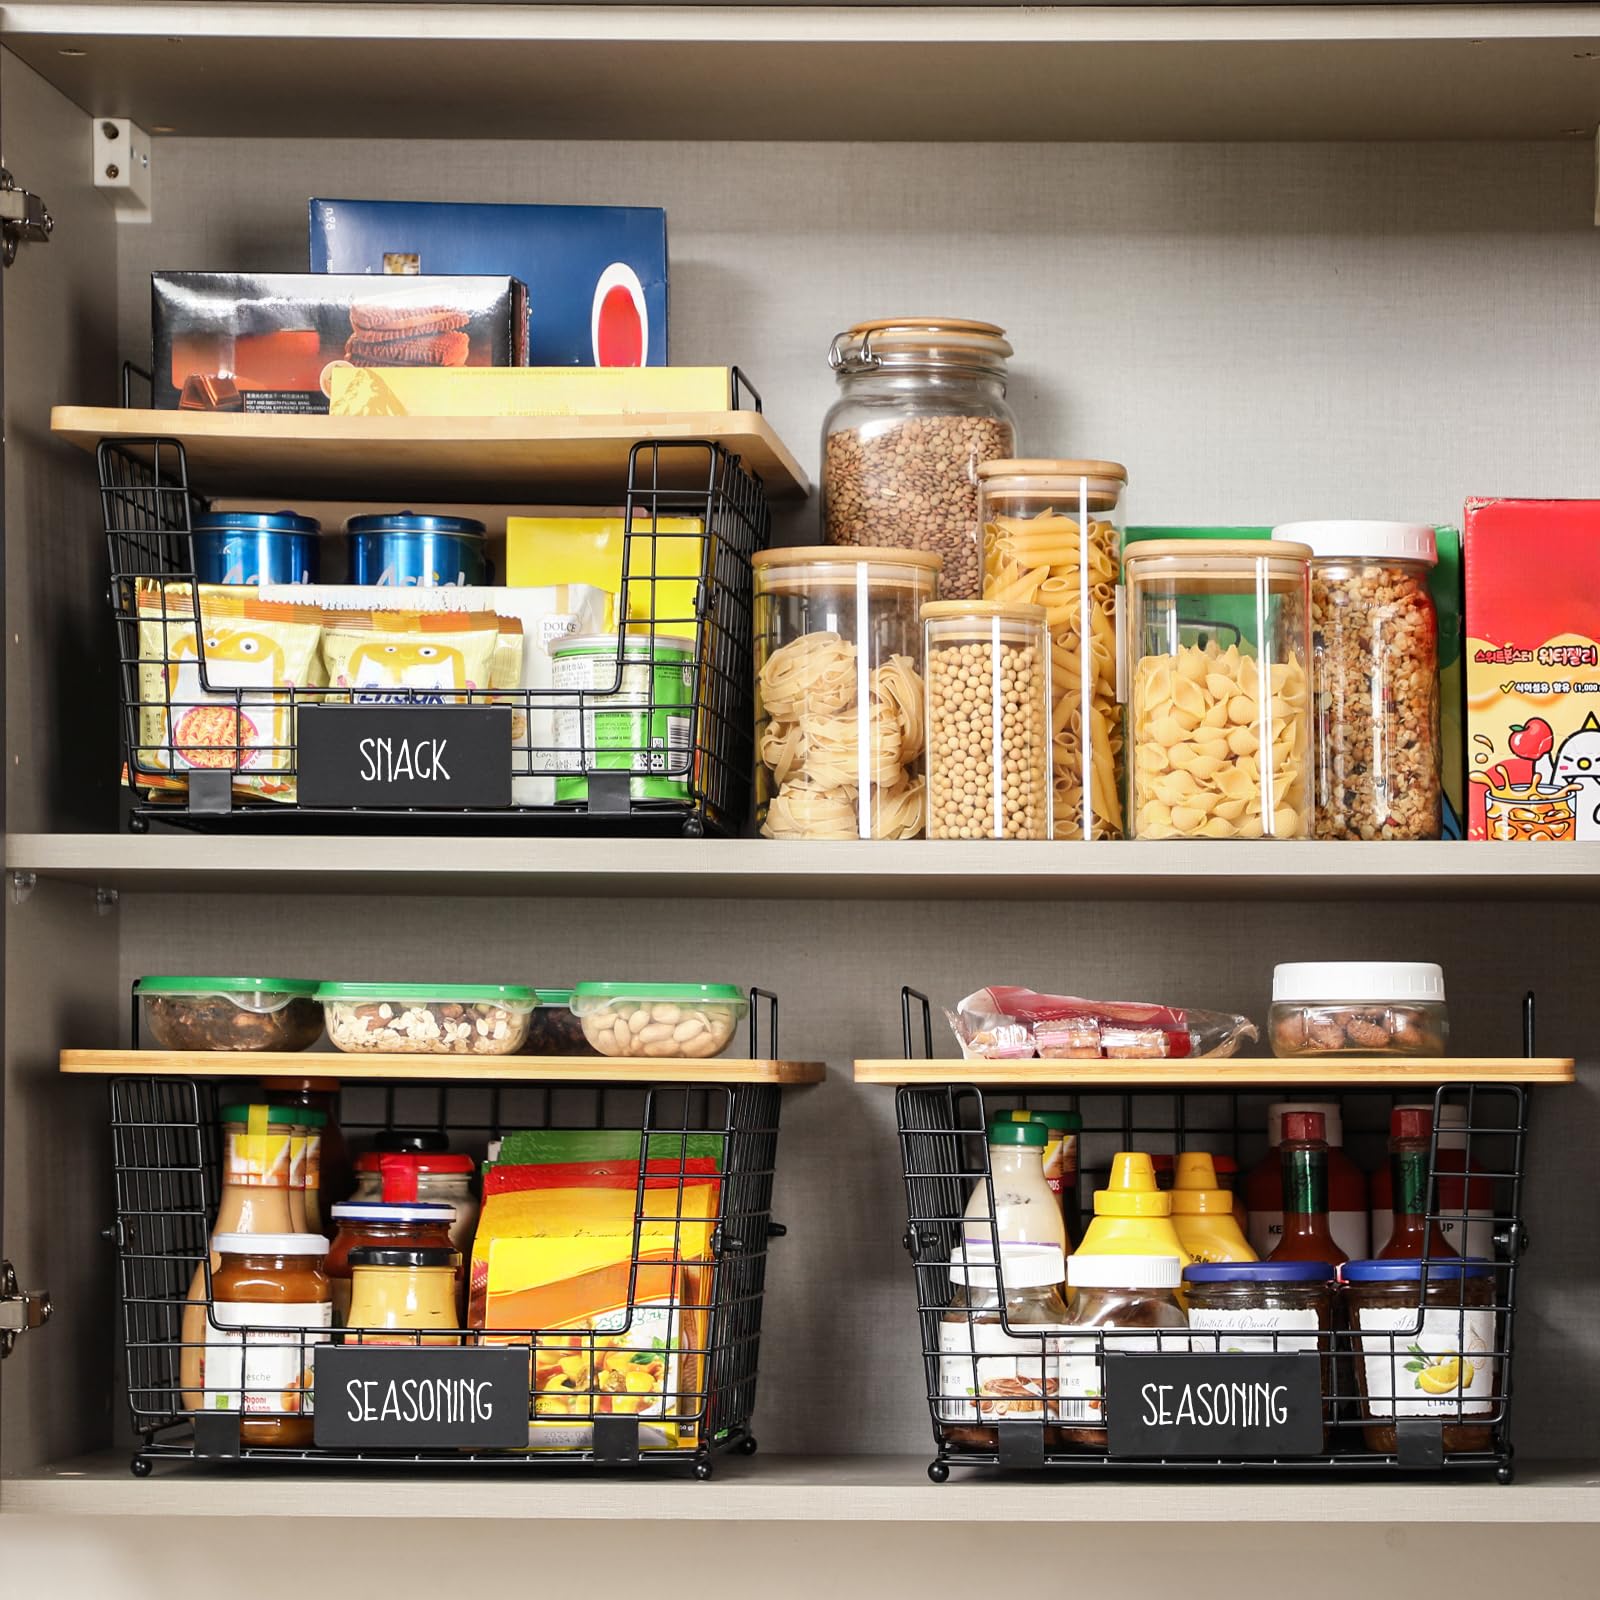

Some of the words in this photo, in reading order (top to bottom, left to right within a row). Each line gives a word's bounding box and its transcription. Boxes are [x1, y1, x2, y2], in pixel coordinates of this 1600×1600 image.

[360, 737, 450, 782] SNACK
[346, 1378, 493, 1423] SEASONING
[1141, 1382, 1288, 1427] SEASONING
